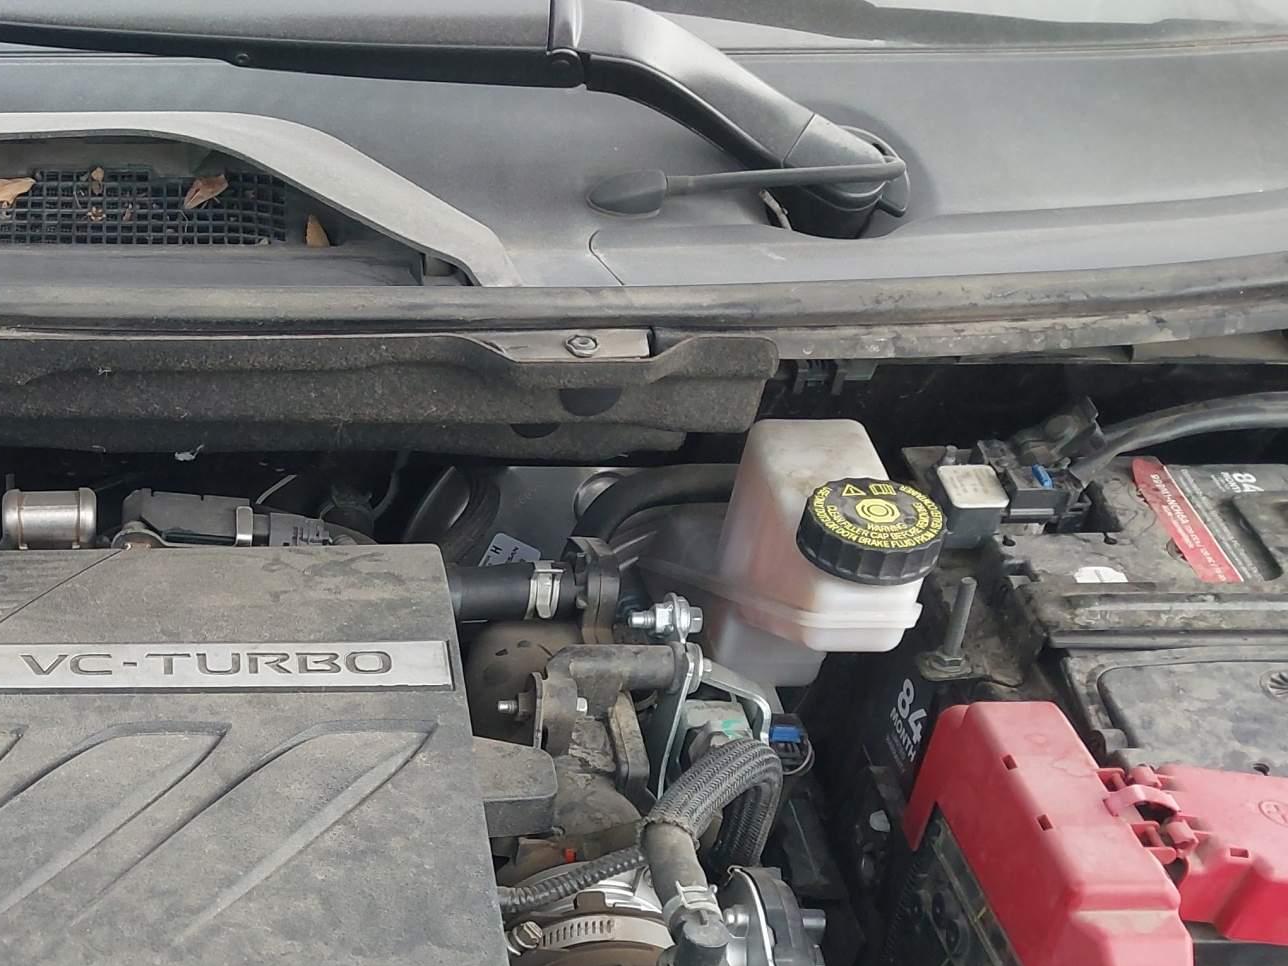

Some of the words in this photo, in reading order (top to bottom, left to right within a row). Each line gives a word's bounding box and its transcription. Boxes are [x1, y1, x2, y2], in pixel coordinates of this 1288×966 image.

[839, 520, 870, 537] FILLER
[870, 531, 890, 539] CAP
[867, 522, 908, 532] WARNING
[858, 536, 890, 547] BRAKE
[20, 650, 393, 676] VC-TURBO
[897, 678, 927, 744] 84
[890, 707, 916, 762] MONTH
